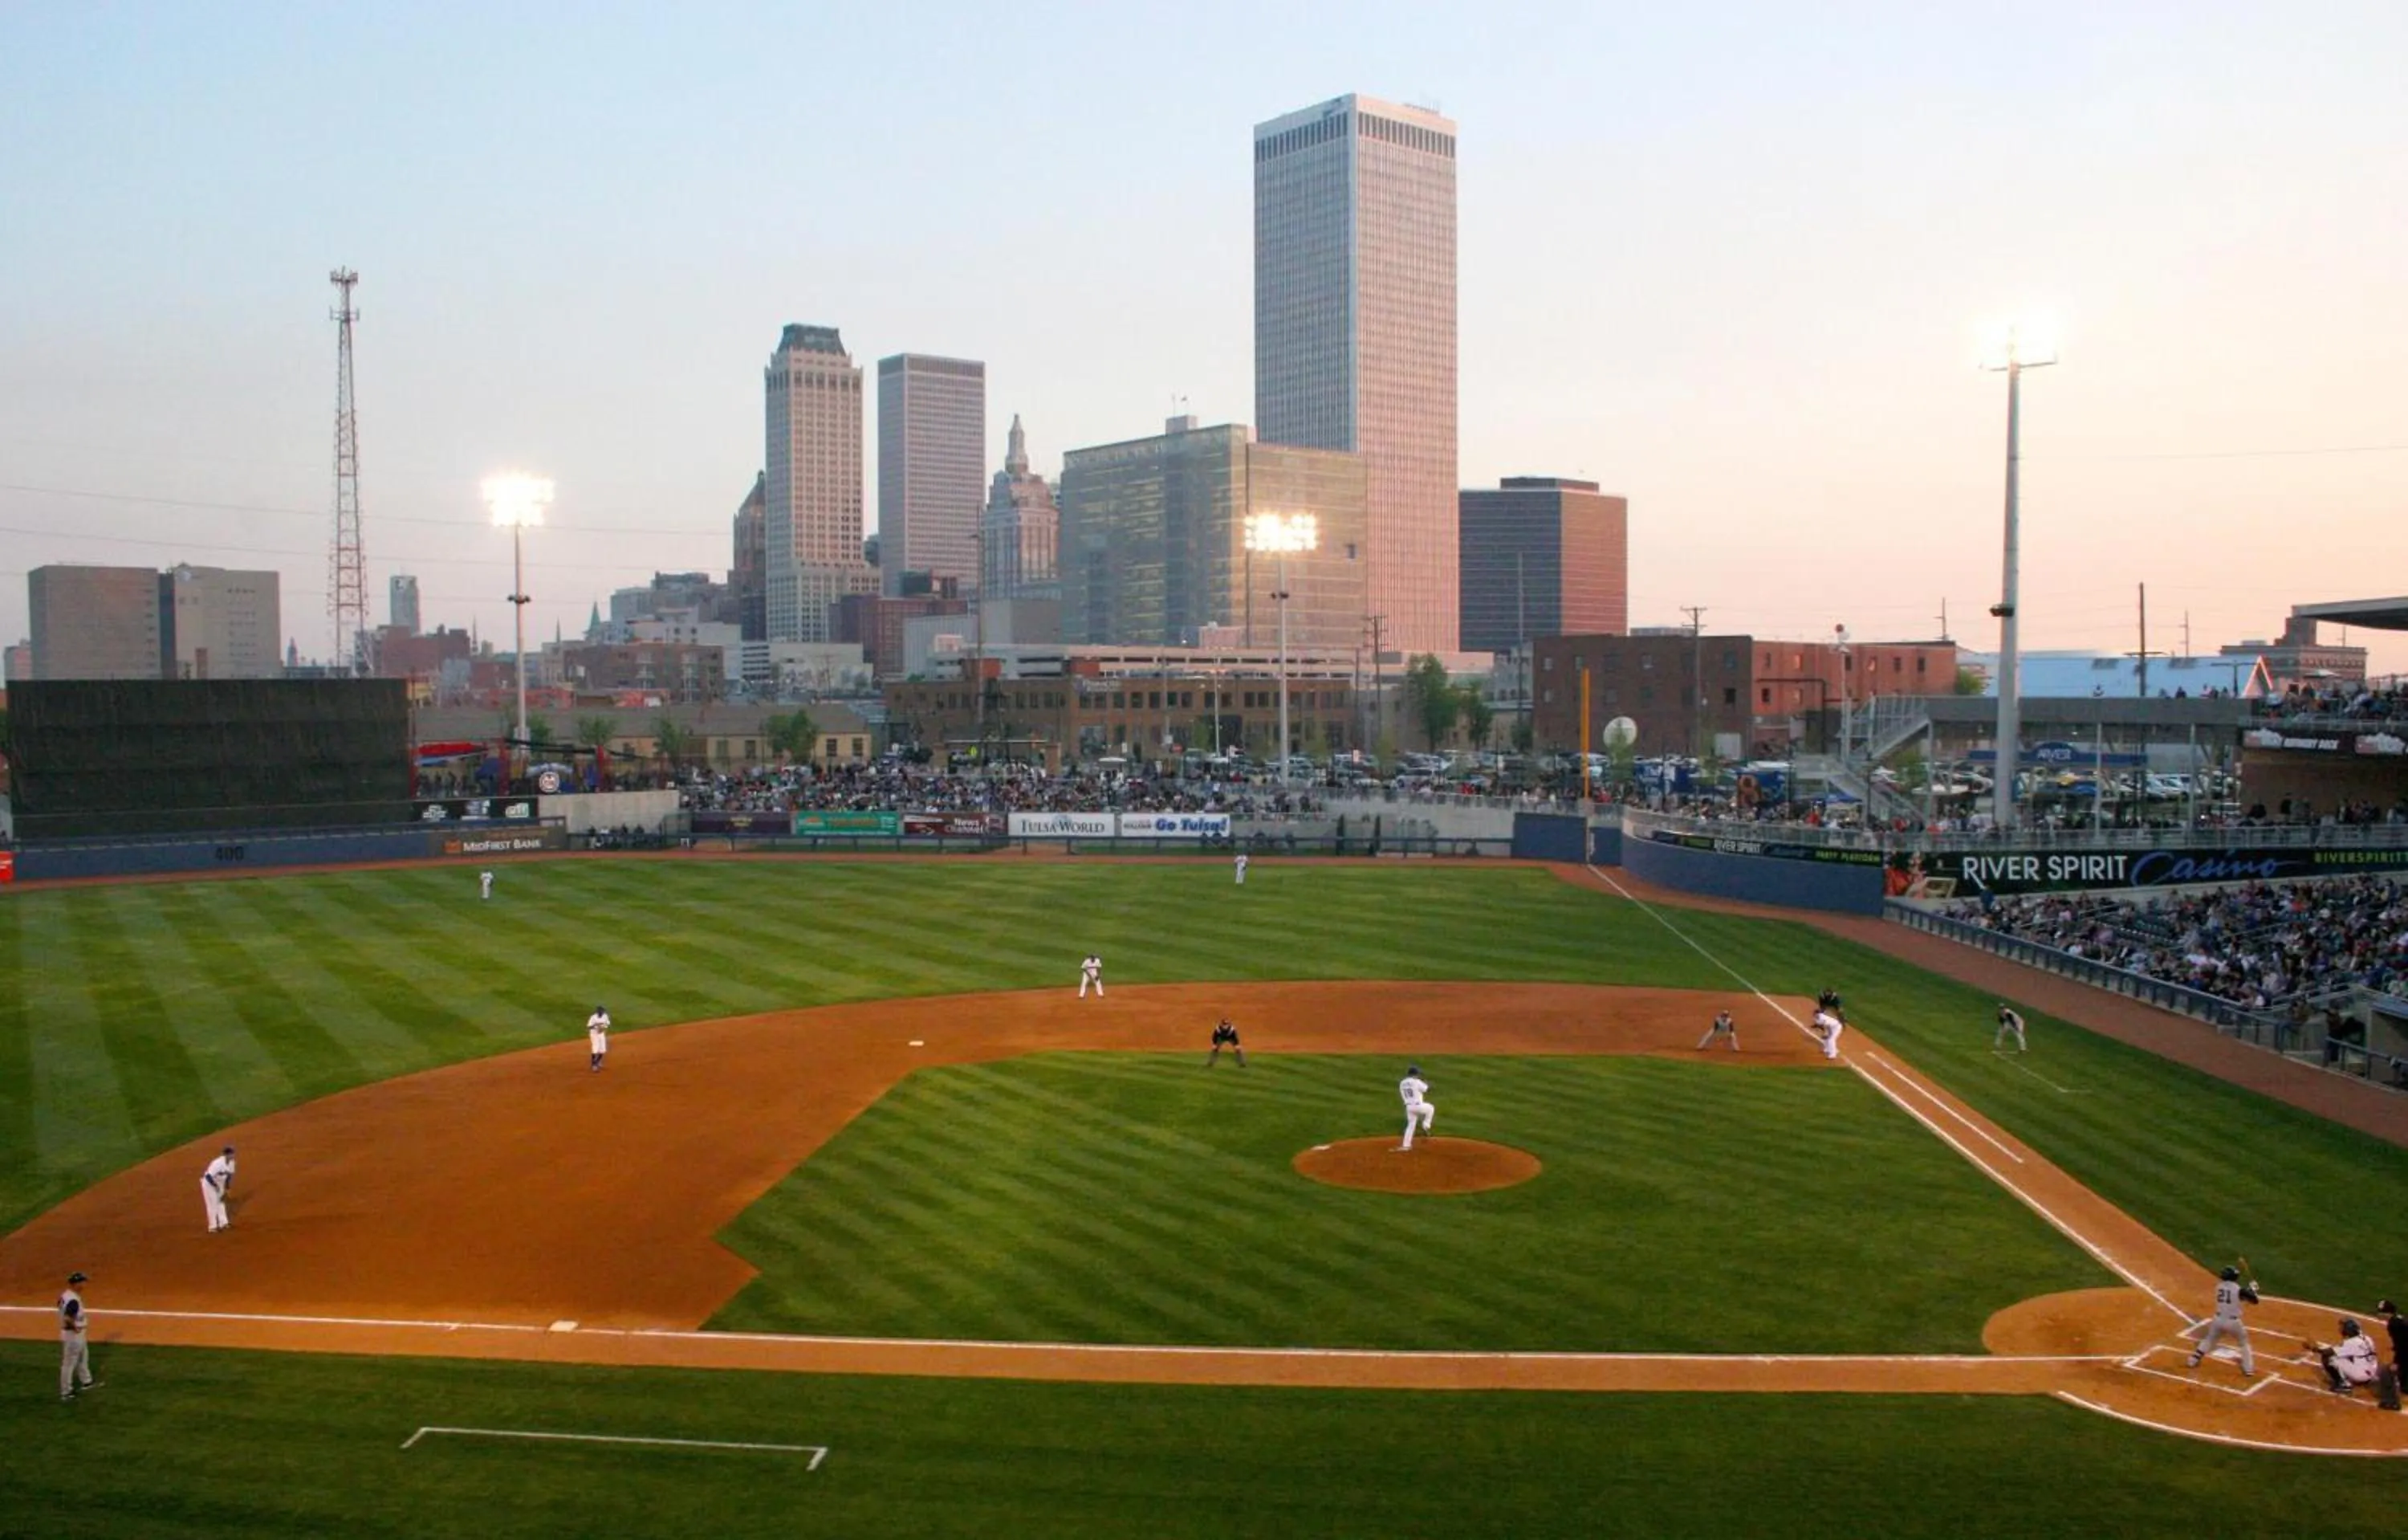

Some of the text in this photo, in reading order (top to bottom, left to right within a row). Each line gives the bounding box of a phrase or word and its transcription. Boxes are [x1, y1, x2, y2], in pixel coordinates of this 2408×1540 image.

[1021, 818, 1105, 833] TULSA WORLD
[1156, 818, 1176, 831] Go
[1181, 817, 1226, 832] Tulsa!
[1963, 849, 2280, 889] RIVER SPIRIT Casino
[2217, 1289, 2231, 1304] 21
